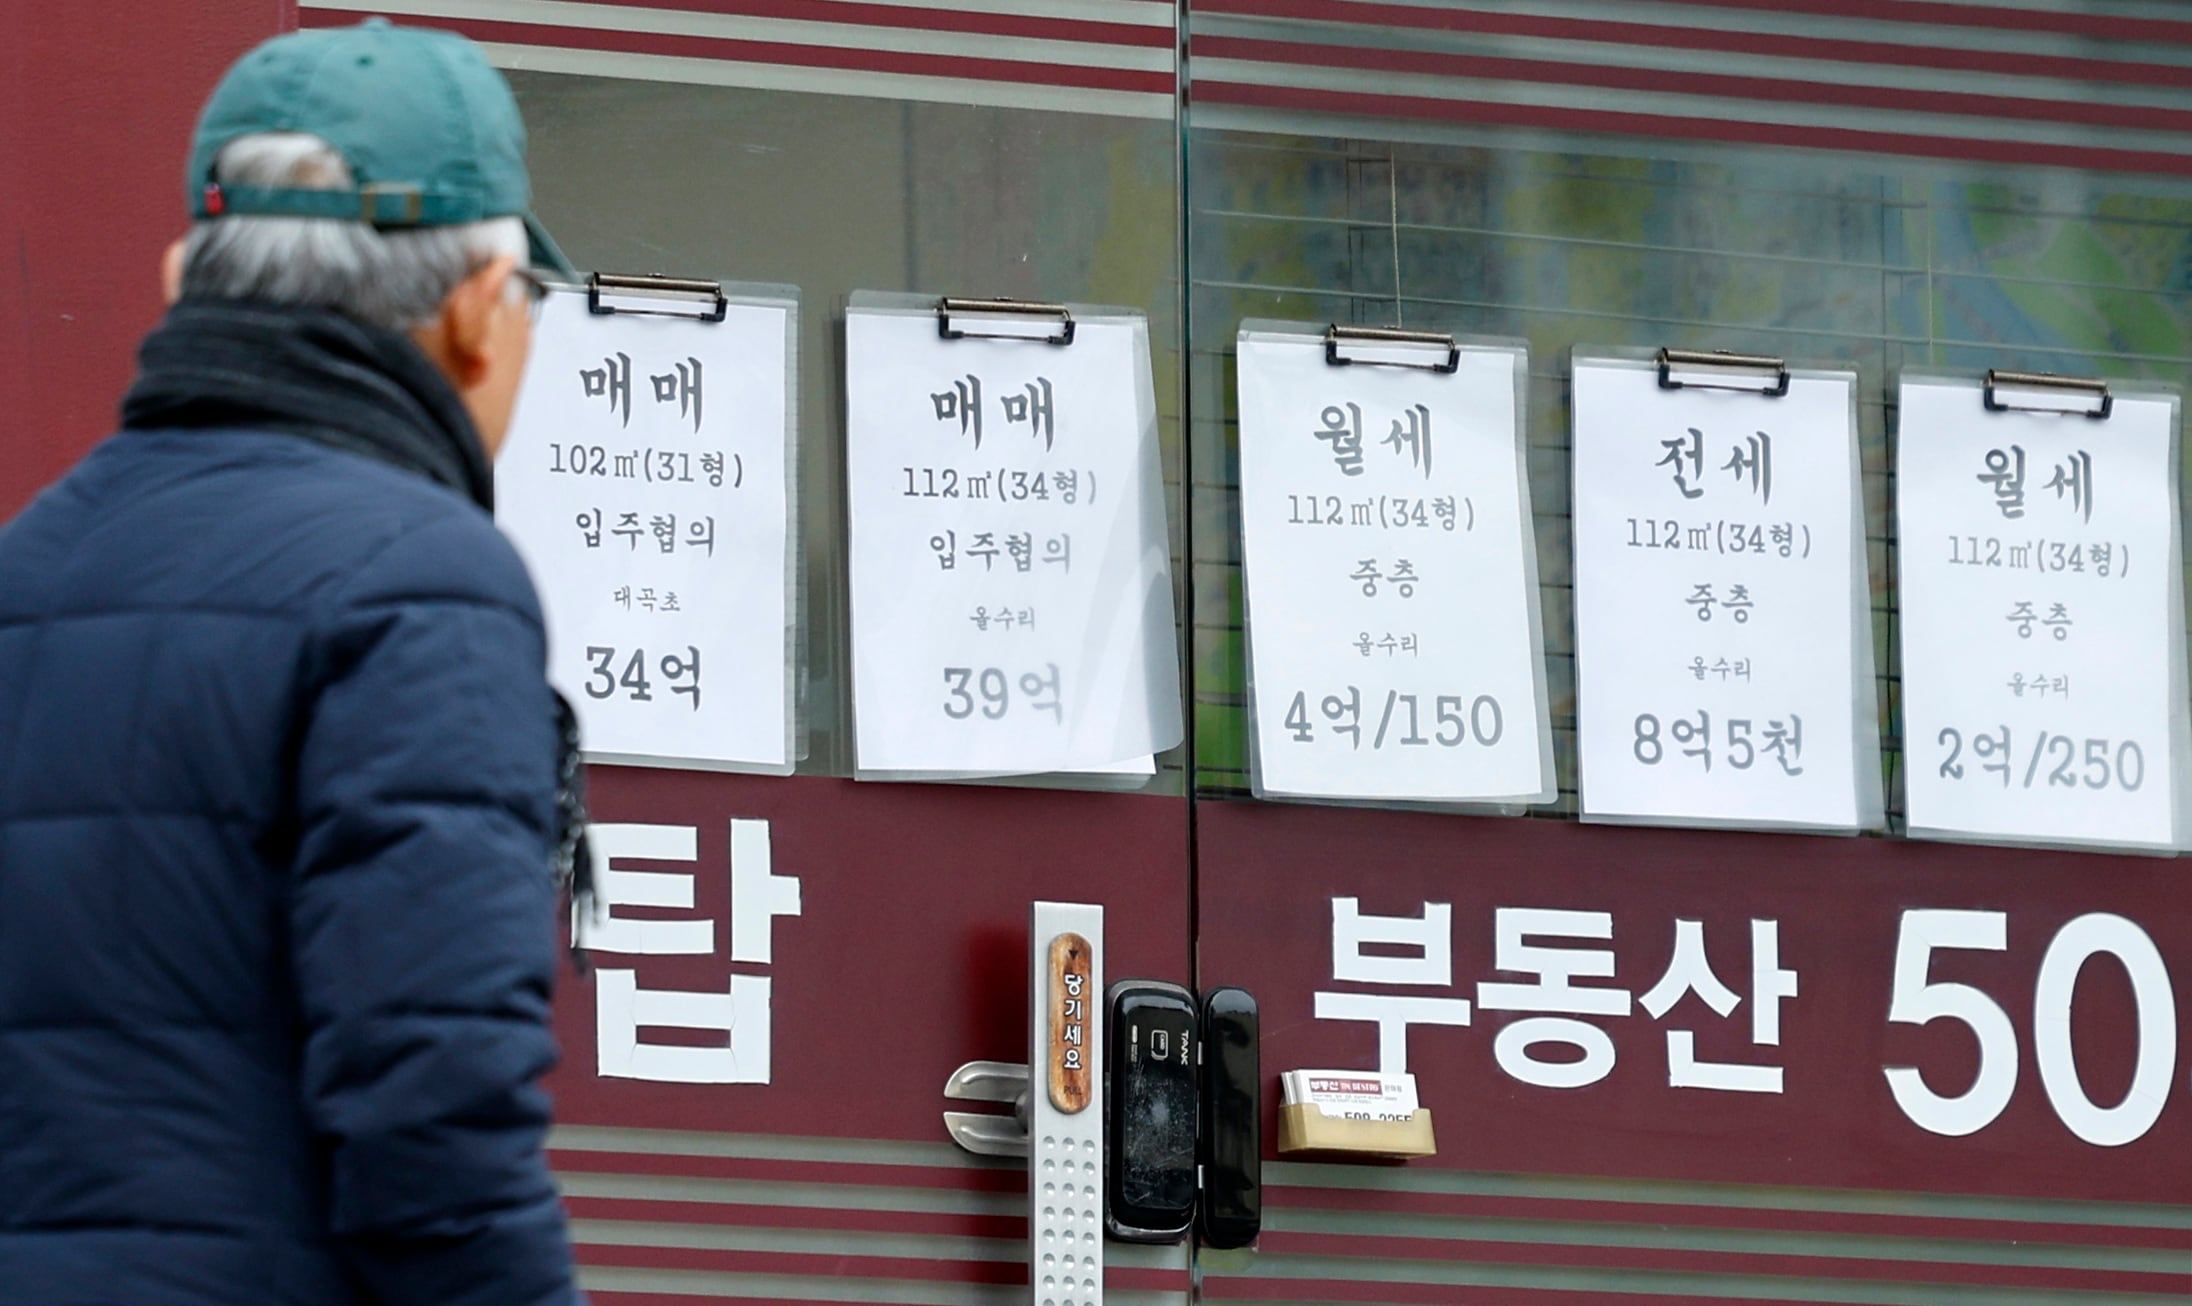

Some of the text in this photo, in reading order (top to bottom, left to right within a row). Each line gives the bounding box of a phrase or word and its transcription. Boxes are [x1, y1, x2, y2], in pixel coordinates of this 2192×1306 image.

[576, 507, 714, 557] 입주협의
[930, 529, 1069, 572] 입주협의
[614, 585, 680, 612] 대곡초
[1350, 558, 1419, 598] 중층
[969, 606, 1034, 631] 올수리
[1685, 583, 1754, 623] 중층
[2006, 601, 2073, 641] 중층
[1353, 632, 1417, 657] 올수리
[585, 646, 700, 711] 34억
[1688, 656, 1750, 682] 올수리
[2007, 672, 2068, 698] 올수리
[944, 664, 1061, 723] 39억
[1284, 686, 1503, 750] 4억/150
[1938, 725, 2144, 792] 2억/250
[571, 818, 802, 1085] 탑
[1063, 974, 1083, 1069] 당기세요
[1314, 896, 2176, 1147] 부동산 50
[1180, 1029, 1189, 1066] TANK
